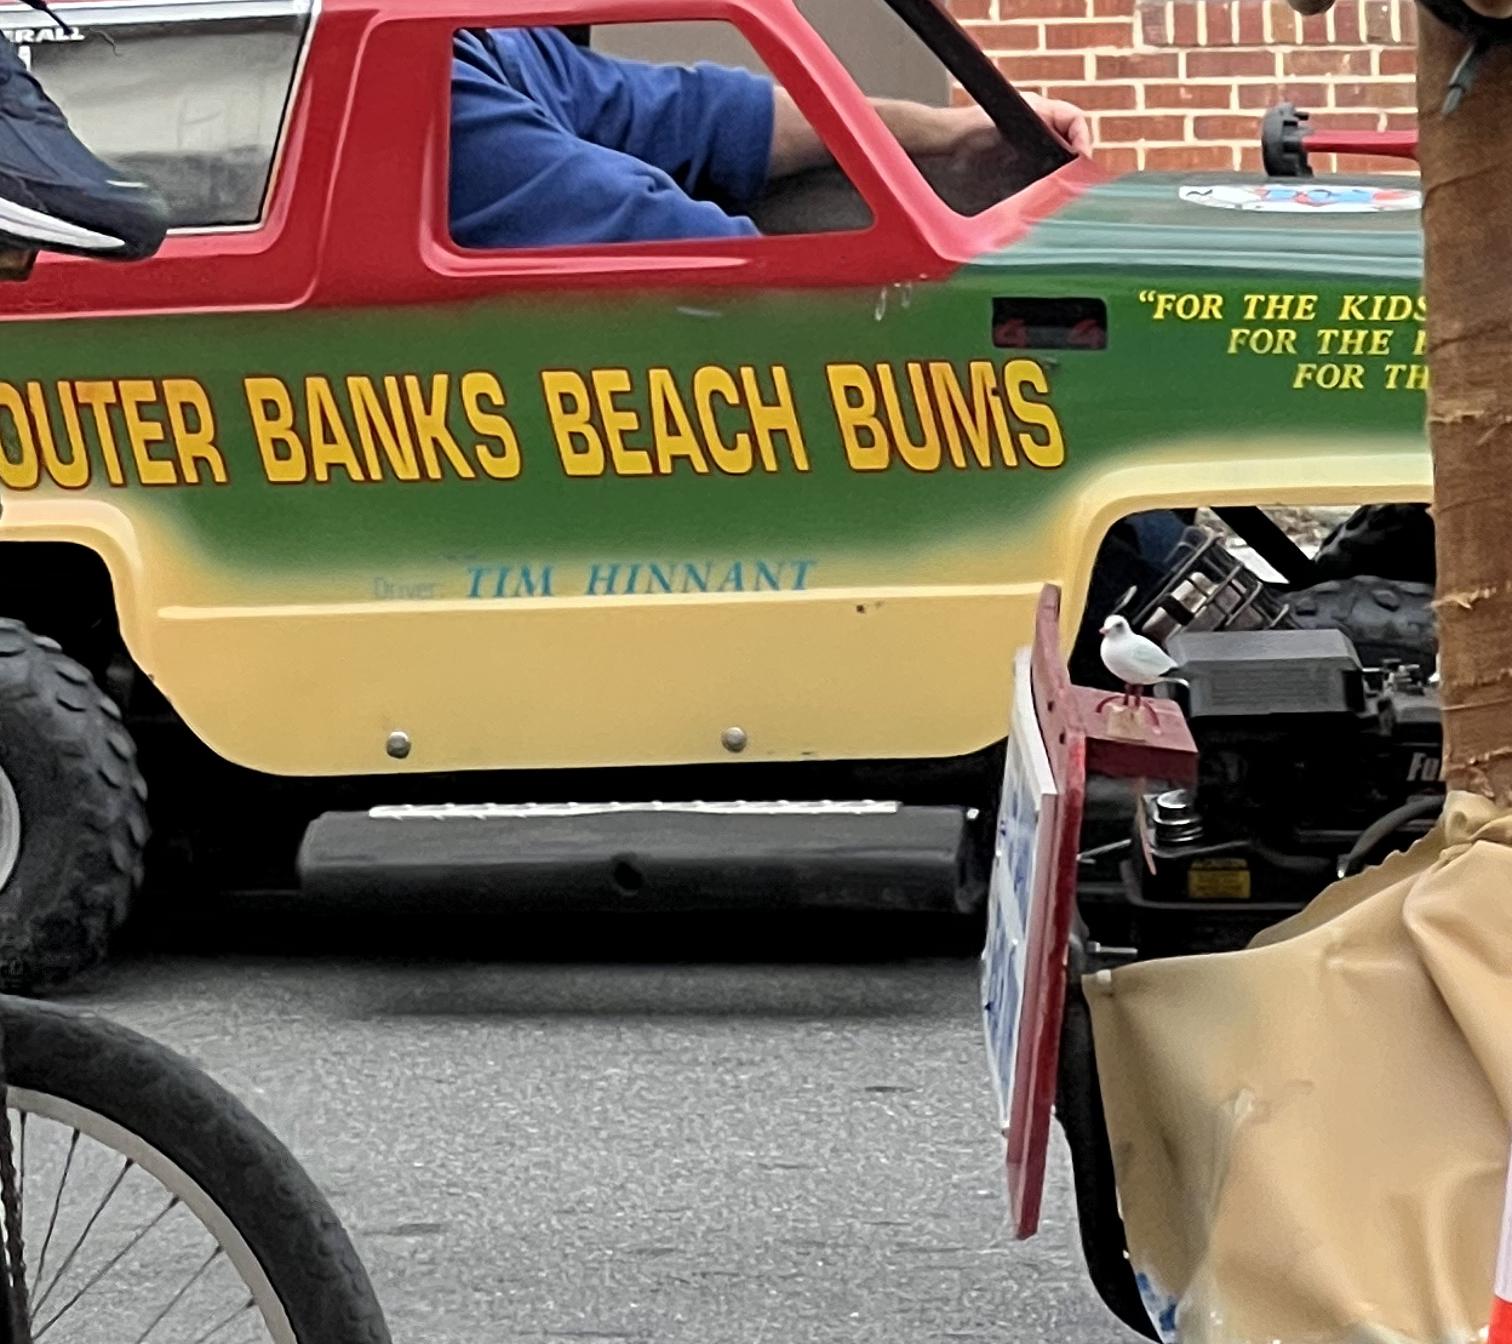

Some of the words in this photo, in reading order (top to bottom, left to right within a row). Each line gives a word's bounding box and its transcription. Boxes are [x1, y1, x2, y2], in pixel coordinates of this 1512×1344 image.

[1243, 294, 1318, 321] THE
[1227, 328, 1298, 355] FOR
[1317, 329, 1393, 356] THE
[1292, 363, 1365, 390] FOR
[242, 370, 522, 485] BANKS
[540, 364, 812, 478] BEACH
[824, 357, 1067, 472] BUMS
[466, 562, 556, 599] TIM
[586, 558, 819, 596] HINNANT
